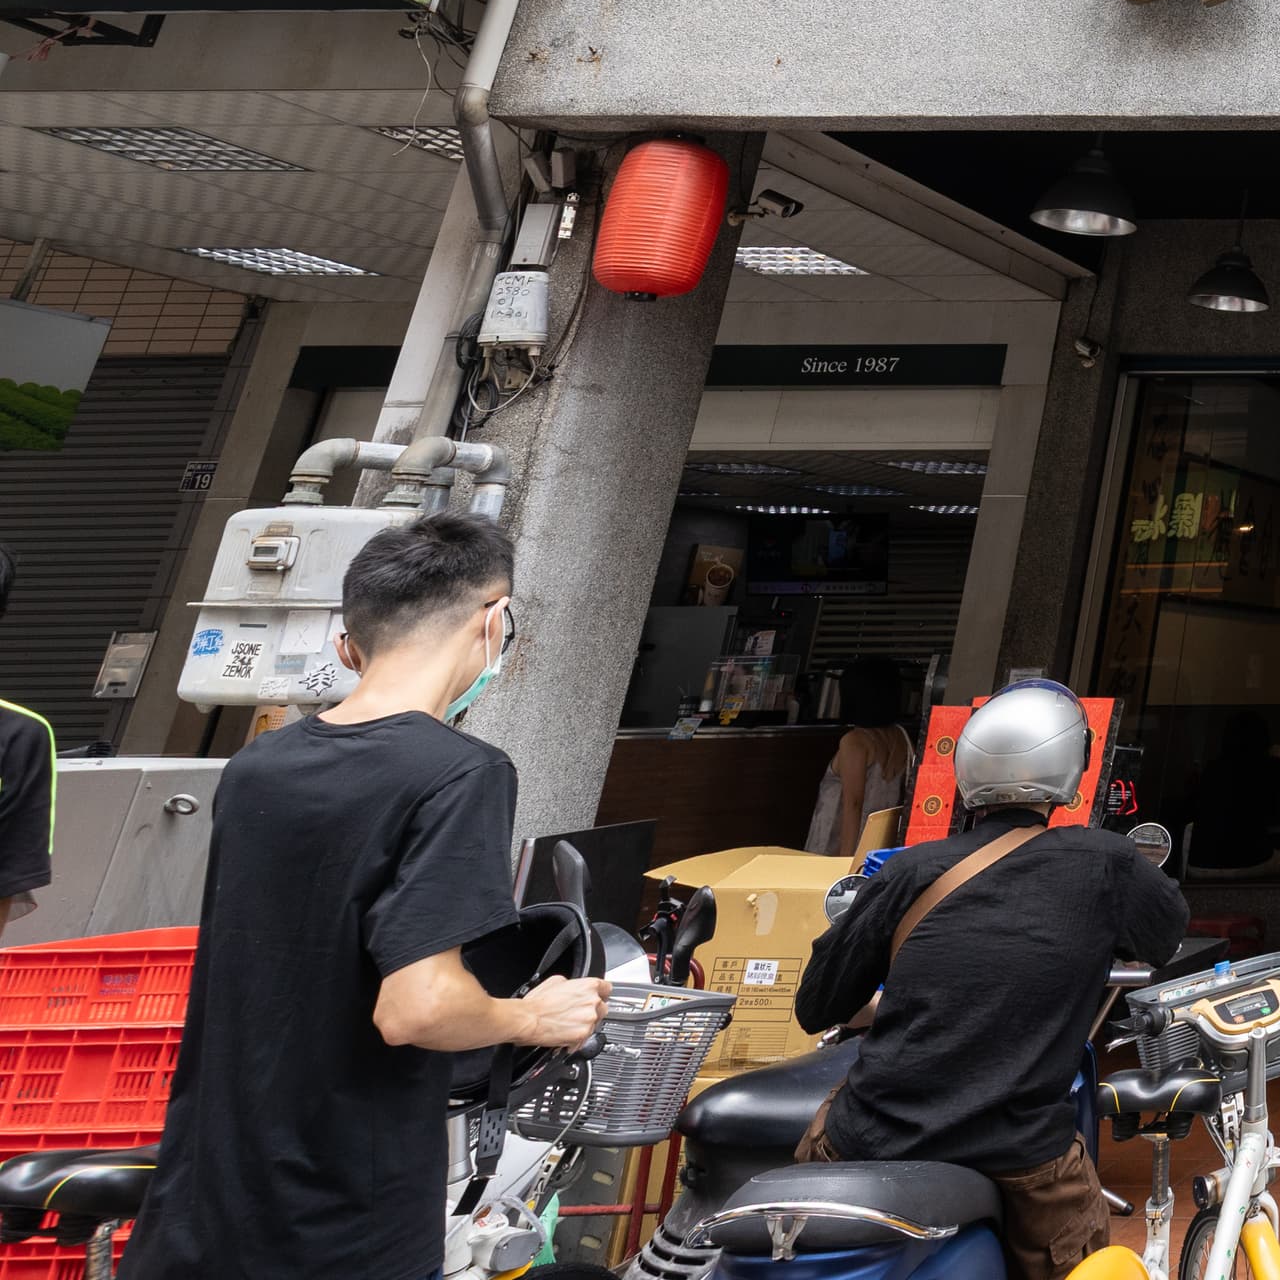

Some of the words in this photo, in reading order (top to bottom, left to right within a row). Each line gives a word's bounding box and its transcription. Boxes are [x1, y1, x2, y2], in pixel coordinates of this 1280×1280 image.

[801, 357, 848, 373] Since
[855, 357, 900, 373] 1987
[194, 473, 211, 489] 19
